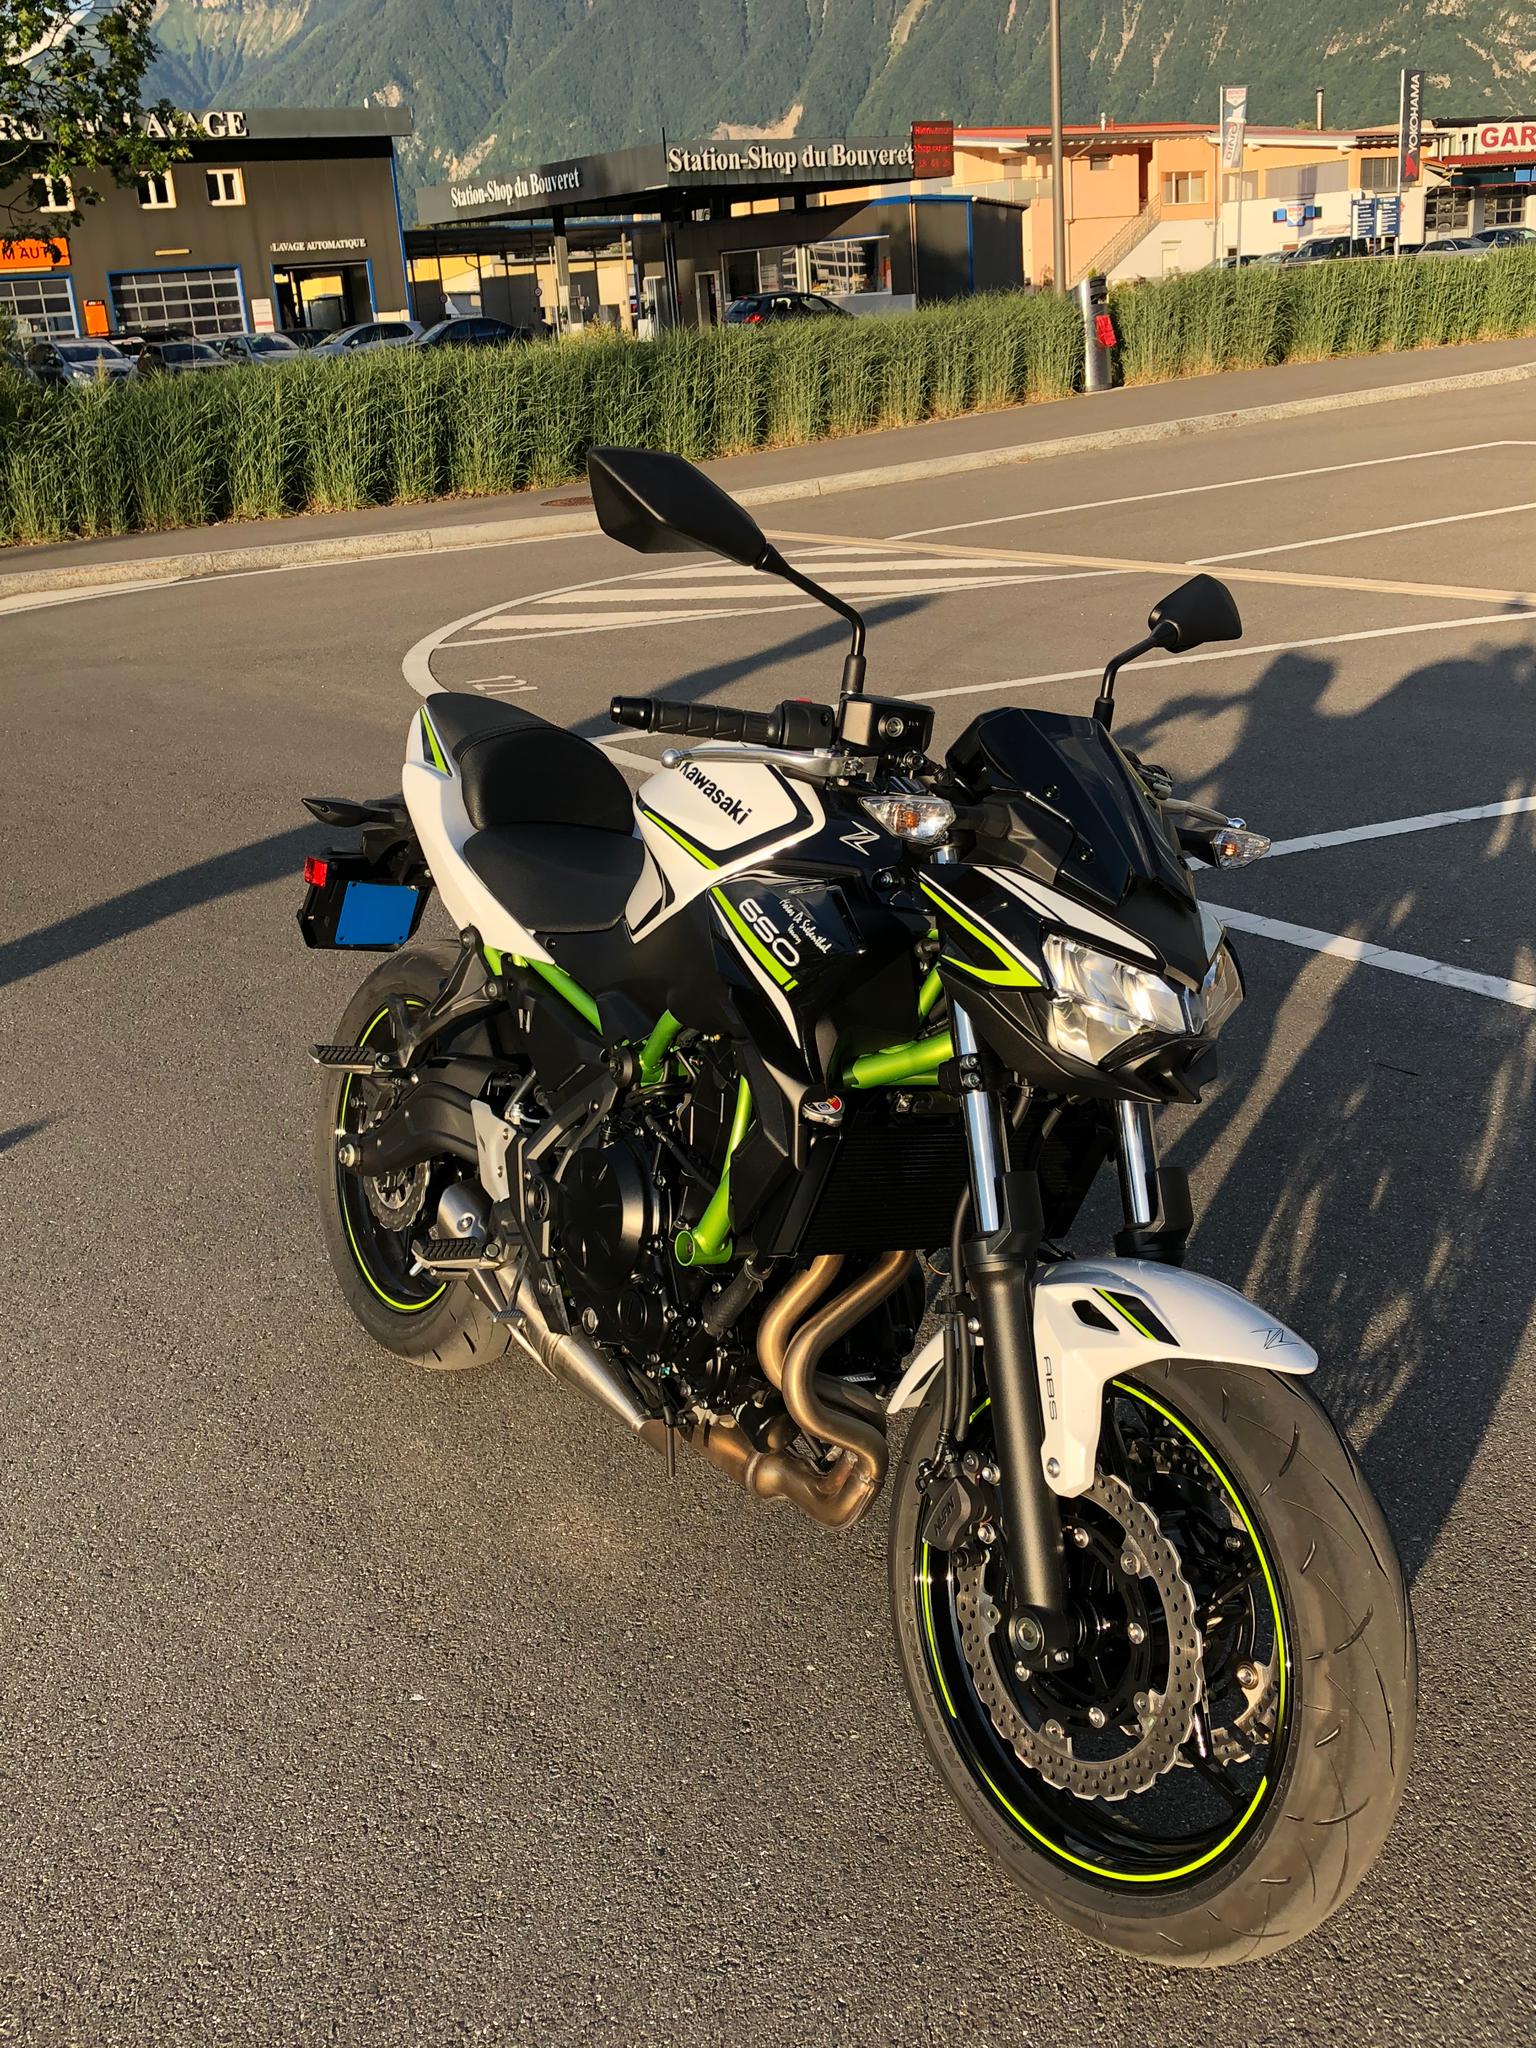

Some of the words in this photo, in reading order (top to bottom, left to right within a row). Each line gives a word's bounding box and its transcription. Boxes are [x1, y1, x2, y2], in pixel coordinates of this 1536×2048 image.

[1408, 74, 1420, 154] YOKOHAMA
[1480, 126, 1536, 148] GAR
[668, 146, 797, 175] Station-Shop
[802, 144, 827, 168] du
[832, 142, 915, 167] Bouveret
[450, 180, 513, 208] Station-Shop
[514, 176, 529, 198] du
[529, 167, 580, 196] Bouveret
[20, 244, 61, 260] AUT
[272, 242, 305, 252] LAVAGE
[307, 238, 367, 251] AUTOMATIQUE
[679, 762, 753, 826] Kawasaki
[739, 898, 800, 967] 650
[1043, 1356, 1058, 1421] ABS
